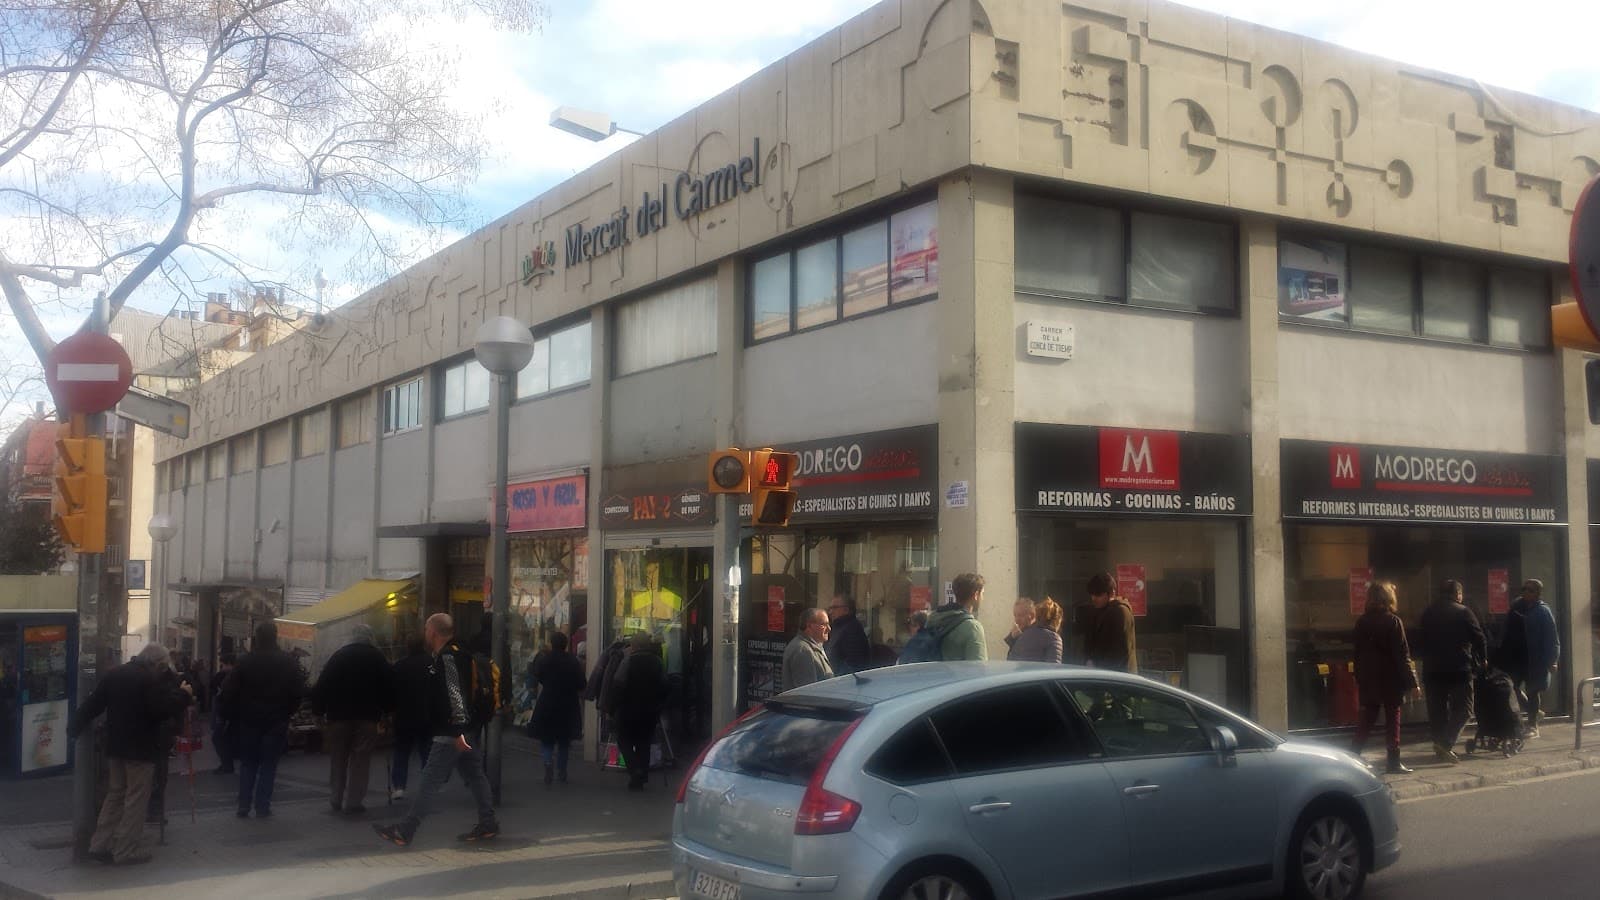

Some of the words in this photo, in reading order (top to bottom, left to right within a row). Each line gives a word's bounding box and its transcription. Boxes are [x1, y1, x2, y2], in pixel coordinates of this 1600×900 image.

[565, 205, 630, 269] Mercat
[636, 183, 667, 238] del
[674, 137, 760, 220] Carmel
[793, 443, 862, 476] ODREGO
[1121, 434, 1153, 473] M
[1335, 452, 1355, 479] M
[1375, 453, 1477, 484] MODREGO
[542, 484, 549, 507] Y
[857, 495, 867, 510] EN
[869, 493, 897, 508] CUINES
[899, 493, 903, 508] I
[904, 491, 931, 507] BANYS
[1038, 490, 1112, 508] REFORMAS
[1125, 492, 1181, 509] COCINAS
[1194, 493, 1235, 511] BAÑOS
[1302, 500, 1356, 515] REFORMES
[1482, 507, 1493, 520] EN
[1495, 506, 1524, 521] CUINES
[1526, 508, 1530, 520] I
[1531, 508, 1556, 521] BANYS
[697, 874, 721, 898] 3218
